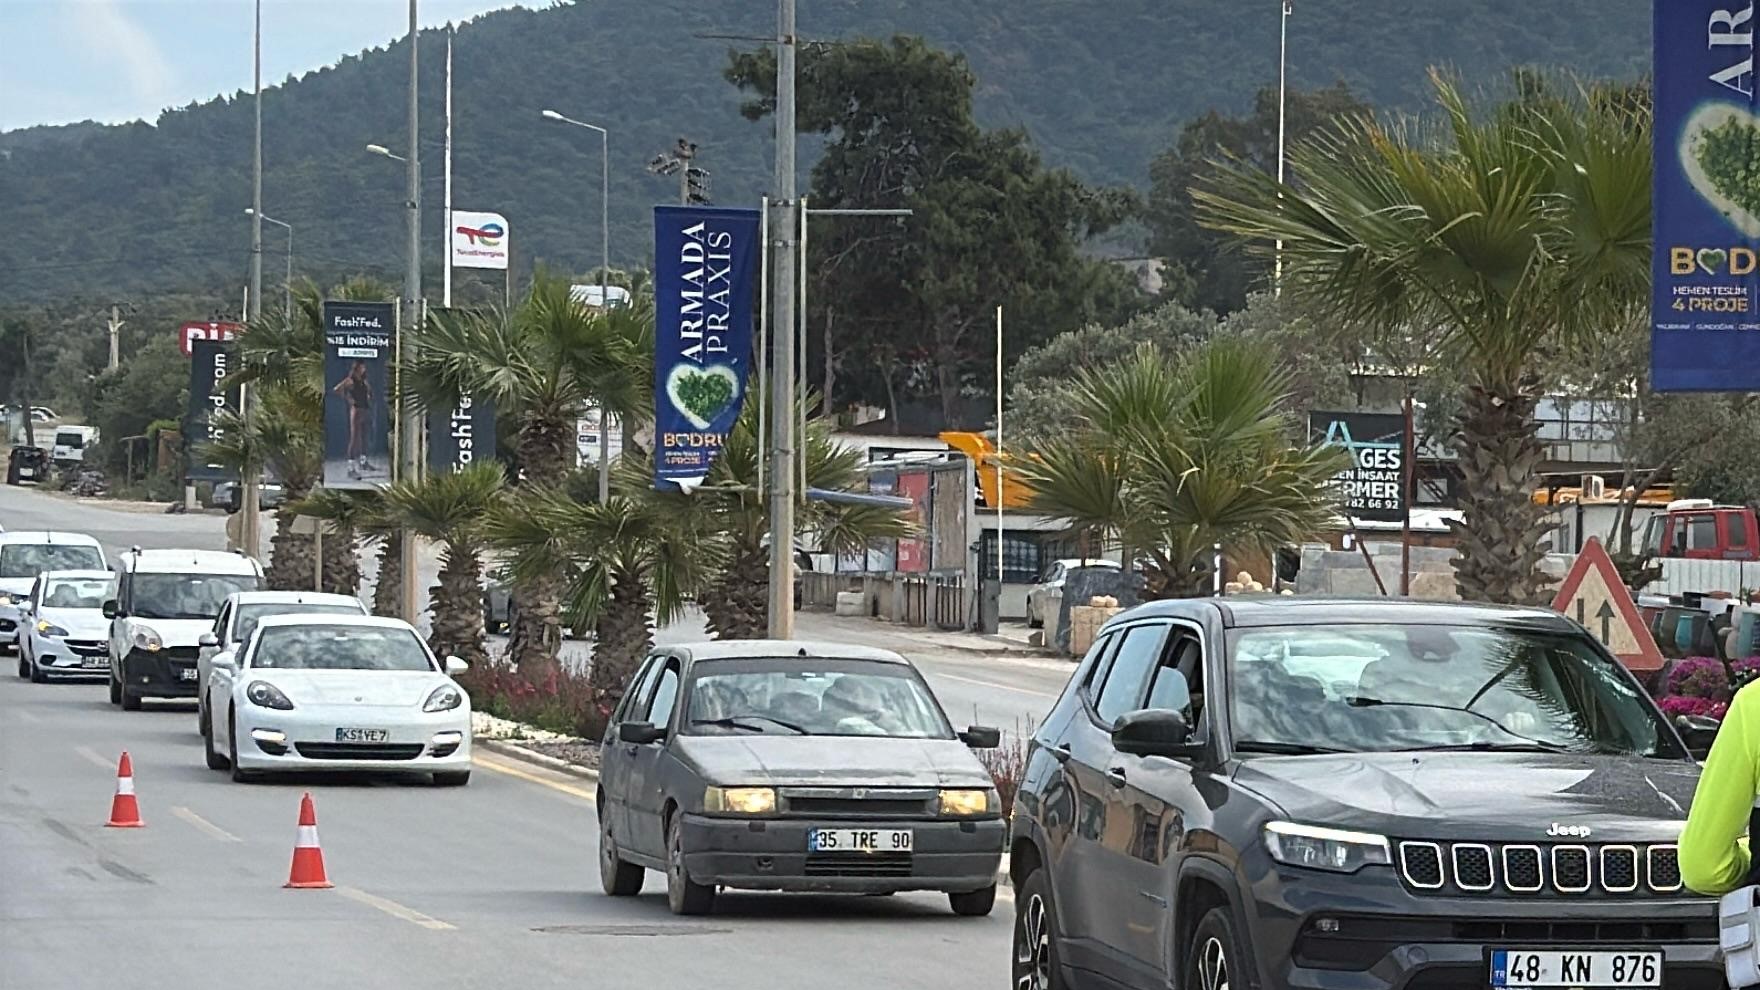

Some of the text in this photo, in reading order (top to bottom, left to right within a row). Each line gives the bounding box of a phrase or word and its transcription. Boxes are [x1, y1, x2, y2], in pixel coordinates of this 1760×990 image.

[680, 221, 705, 363] ARMADA
[706, 231, 731, 354] PRAXIS
[1672, 298, 1749, 312] 4 PROJE
[1368, 499, 1382, 509] 66
[1385, 500, 1399, 510] 92
[1546, 822, 1592, 838] Jeep
[819, 831, 910, 849] 35 TRE 90
[1510, 954, 1656, 983] 48 KN 876
